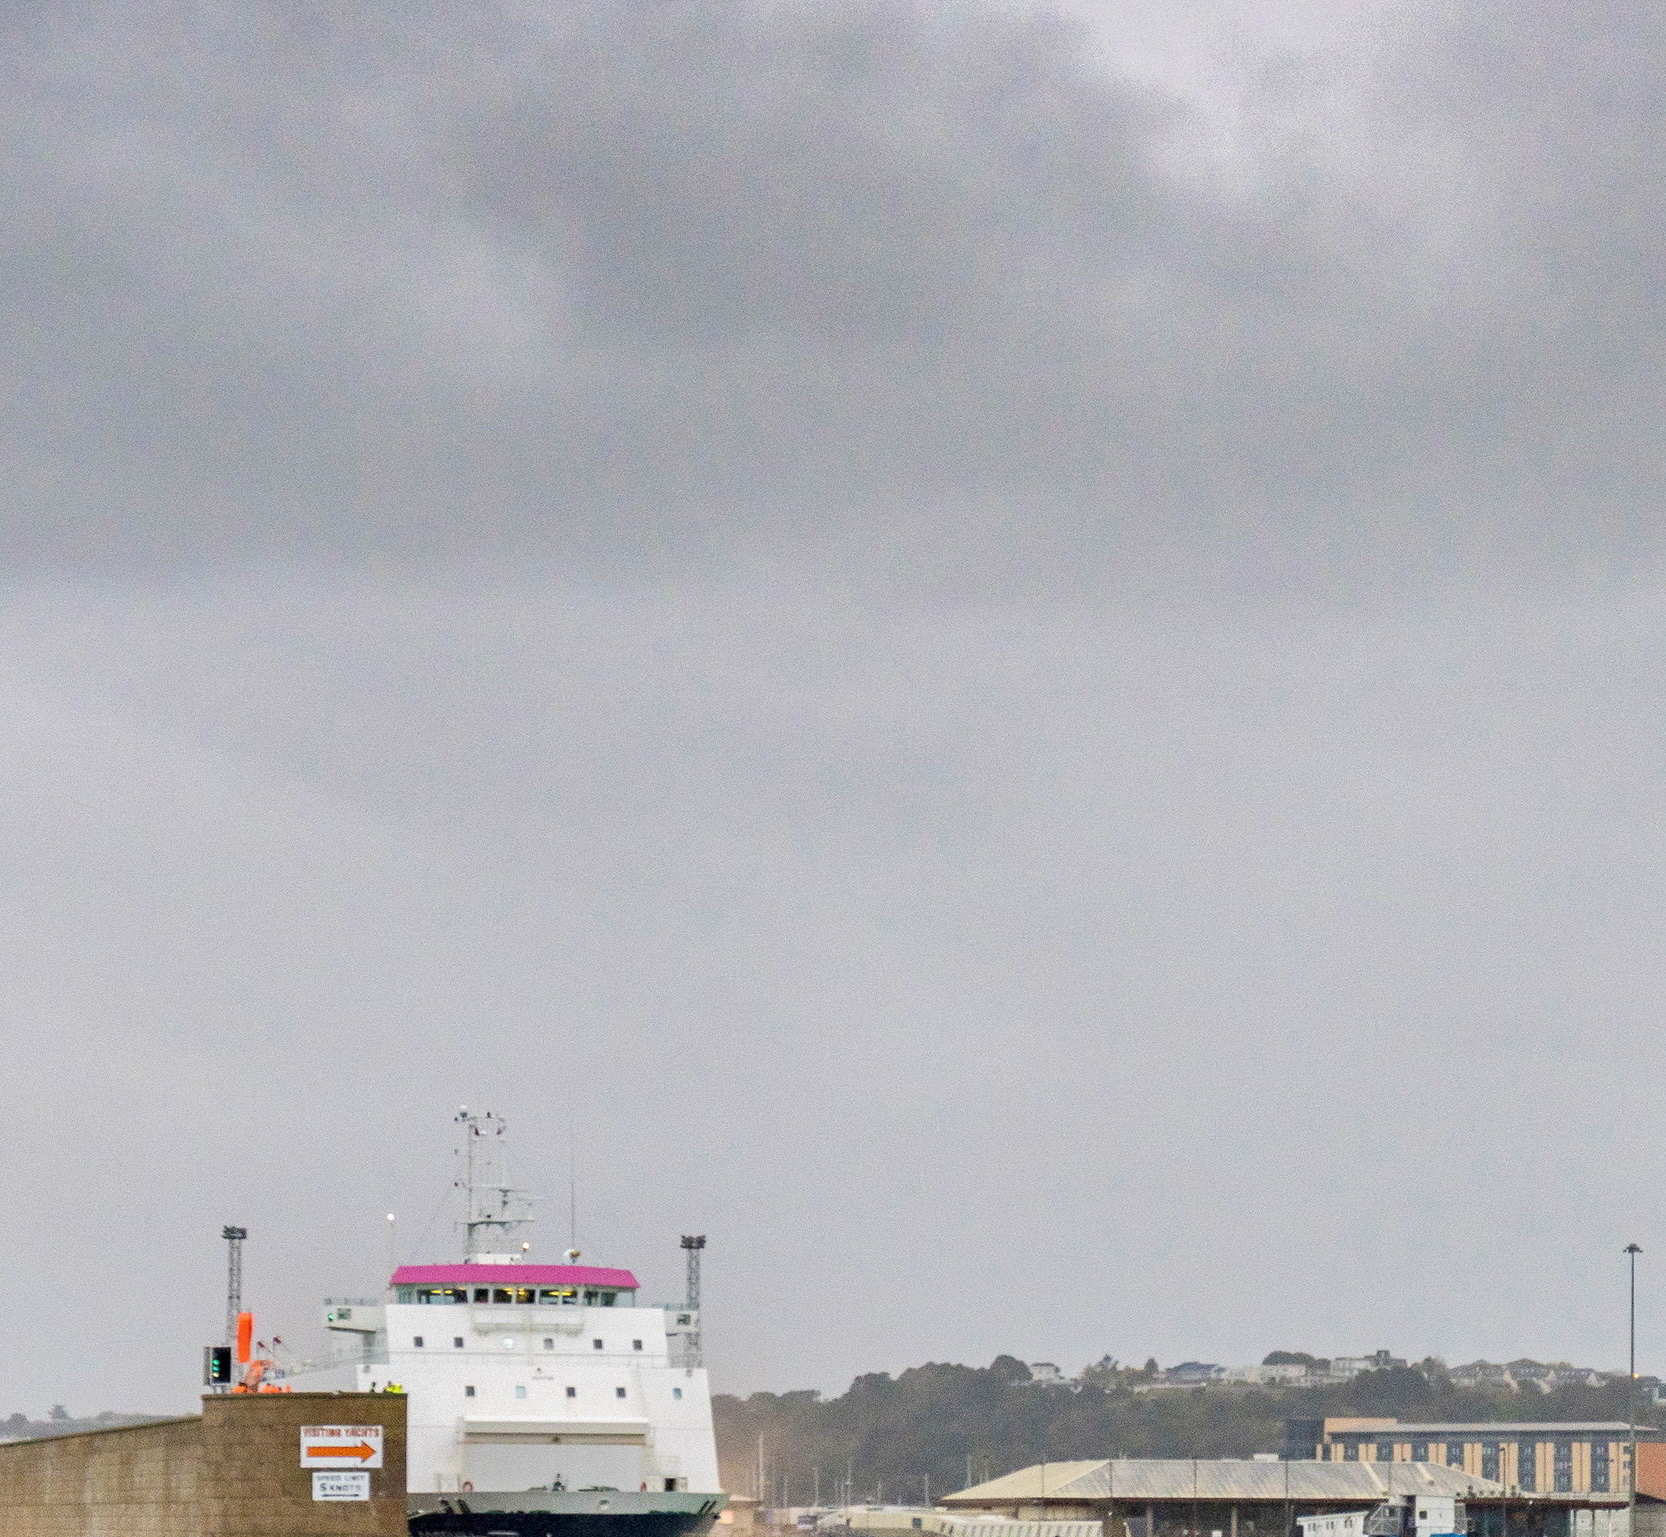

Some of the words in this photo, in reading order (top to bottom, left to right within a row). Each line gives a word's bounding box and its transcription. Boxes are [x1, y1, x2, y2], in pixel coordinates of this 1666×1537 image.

[303, 1427, 341, 1437] VISITING
[344, 1427, 380, 1437] YACHTS
[319, 1483, 327, 1491] 5
[329, 1484, 361, 1492] KNOTS
